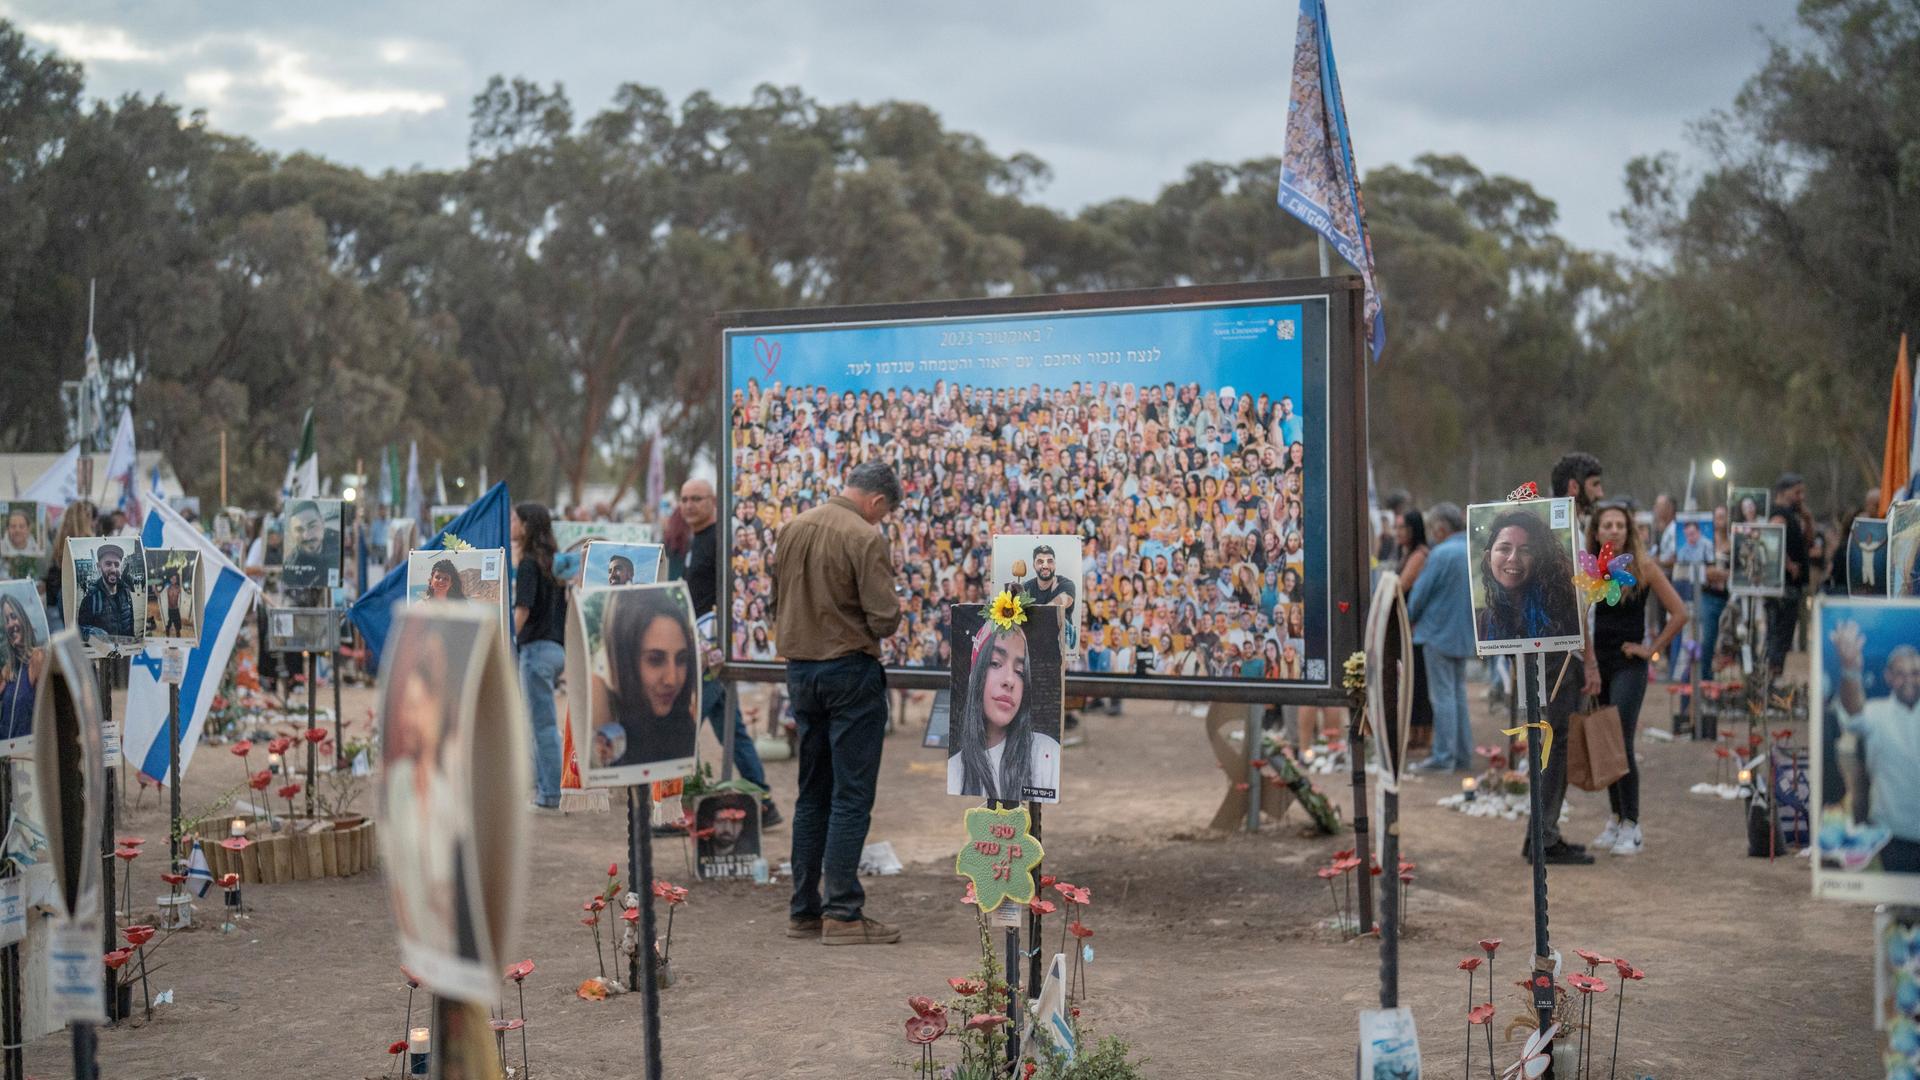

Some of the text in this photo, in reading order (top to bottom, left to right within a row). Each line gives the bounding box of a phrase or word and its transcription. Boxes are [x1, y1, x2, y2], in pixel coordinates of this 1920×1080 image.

[940, 331, 973, 347] 2023
[977, 329, 1041, 345] באוקטובר
[1015, 355, 1033, 368] עם
[1087, 350, 1122, 364] נזכור
[1127, 346, 1161, 362] לנצח
[875, 361, 915, 374] שנדמו
[918, 358, 973, 371] והשמחה
[978, 357, 1009, 369] האור
[989, 823, 1016, 839] שני
[974, 841, 1023, 864] בן עמי
